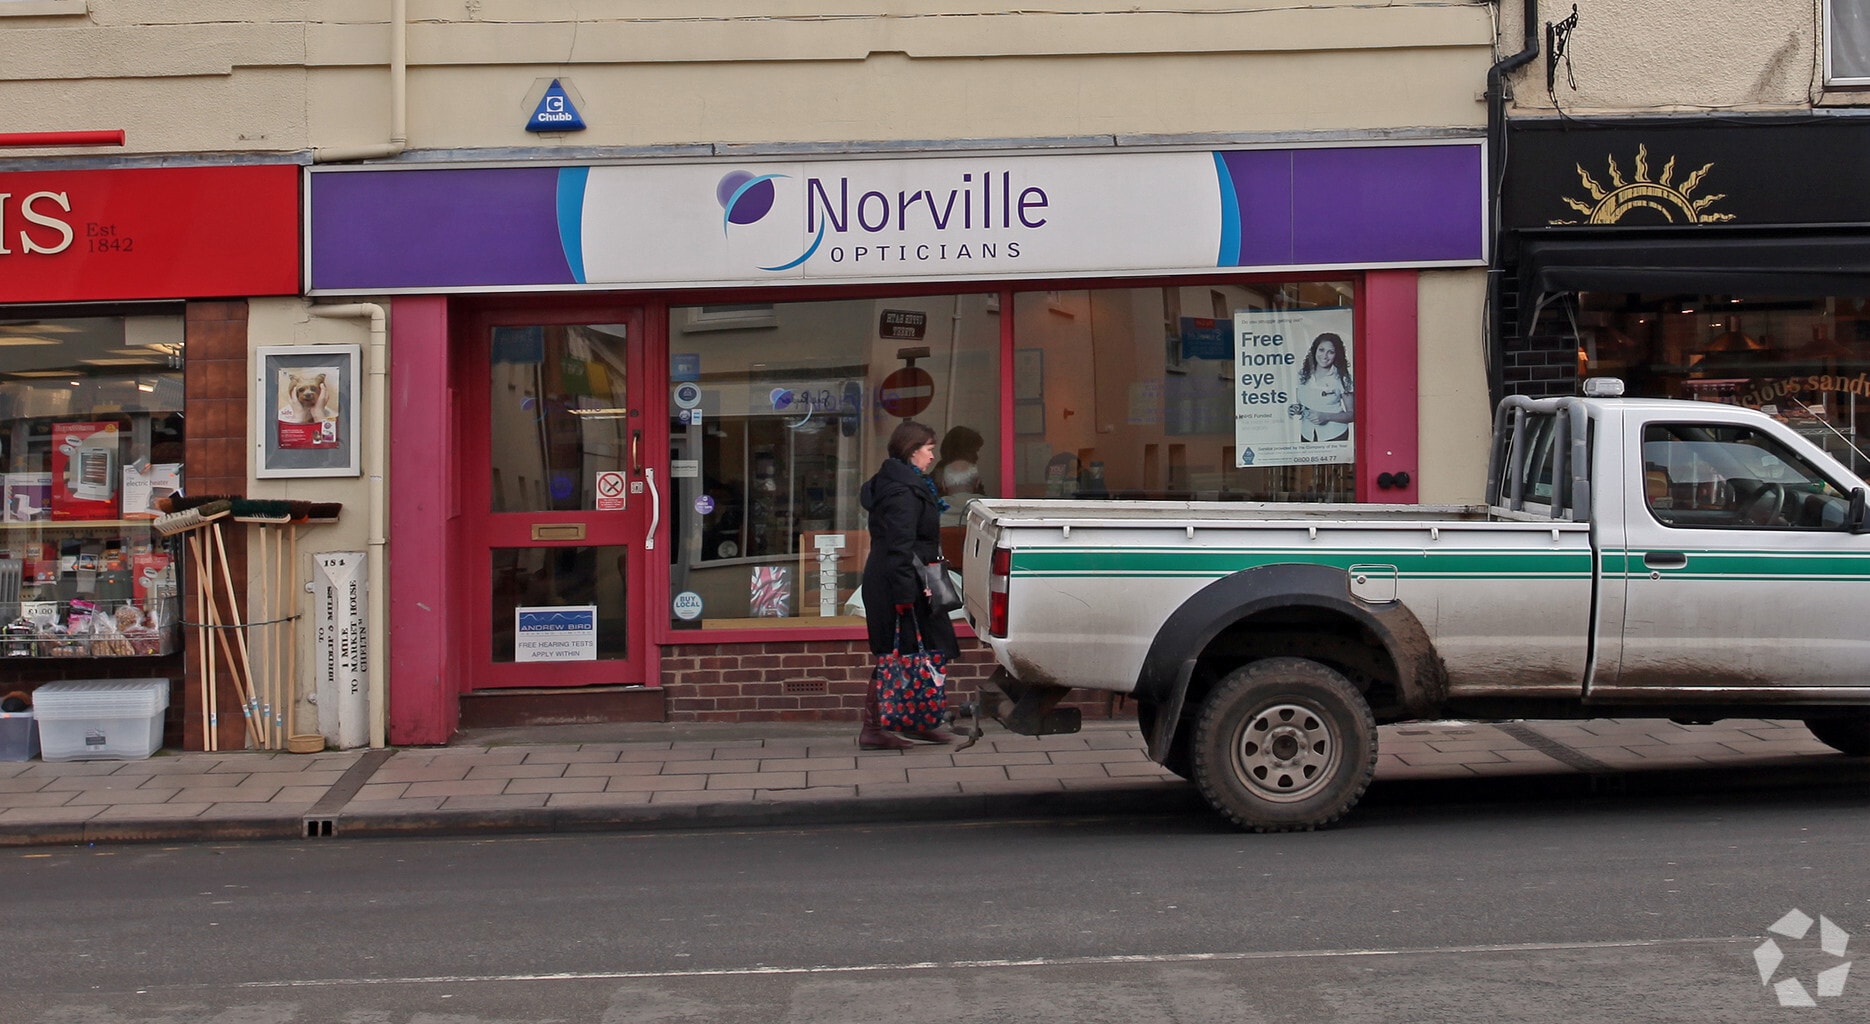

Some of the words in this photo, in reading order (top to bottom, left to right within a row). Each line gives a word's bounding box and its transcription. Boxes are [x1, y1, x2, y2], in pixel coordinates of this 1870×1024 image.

[538, 112, 573, 122] Chubb
[808, 169, 1050, 235] Norville
[86, 222, 116, 238] Est
[87, 238, 134, 253] 1842
[830, 241, 1022, 264] OPTICIANS
[1241, 332, 1284, 347] Free
[1241, 351, 1296, 366] home
[1241, 372, 1275, 389] eye
[1241, 389, 1289, 405] tests
[349, 579, 357, 616] HOUSE
[318, 627, 325, 643] TO
[341, 627, 349, 658] MILE
[350, 621, 358, 673] MARKET
[518, 641, 537, 649] FREE
[351, 678, 359, 695] TO
